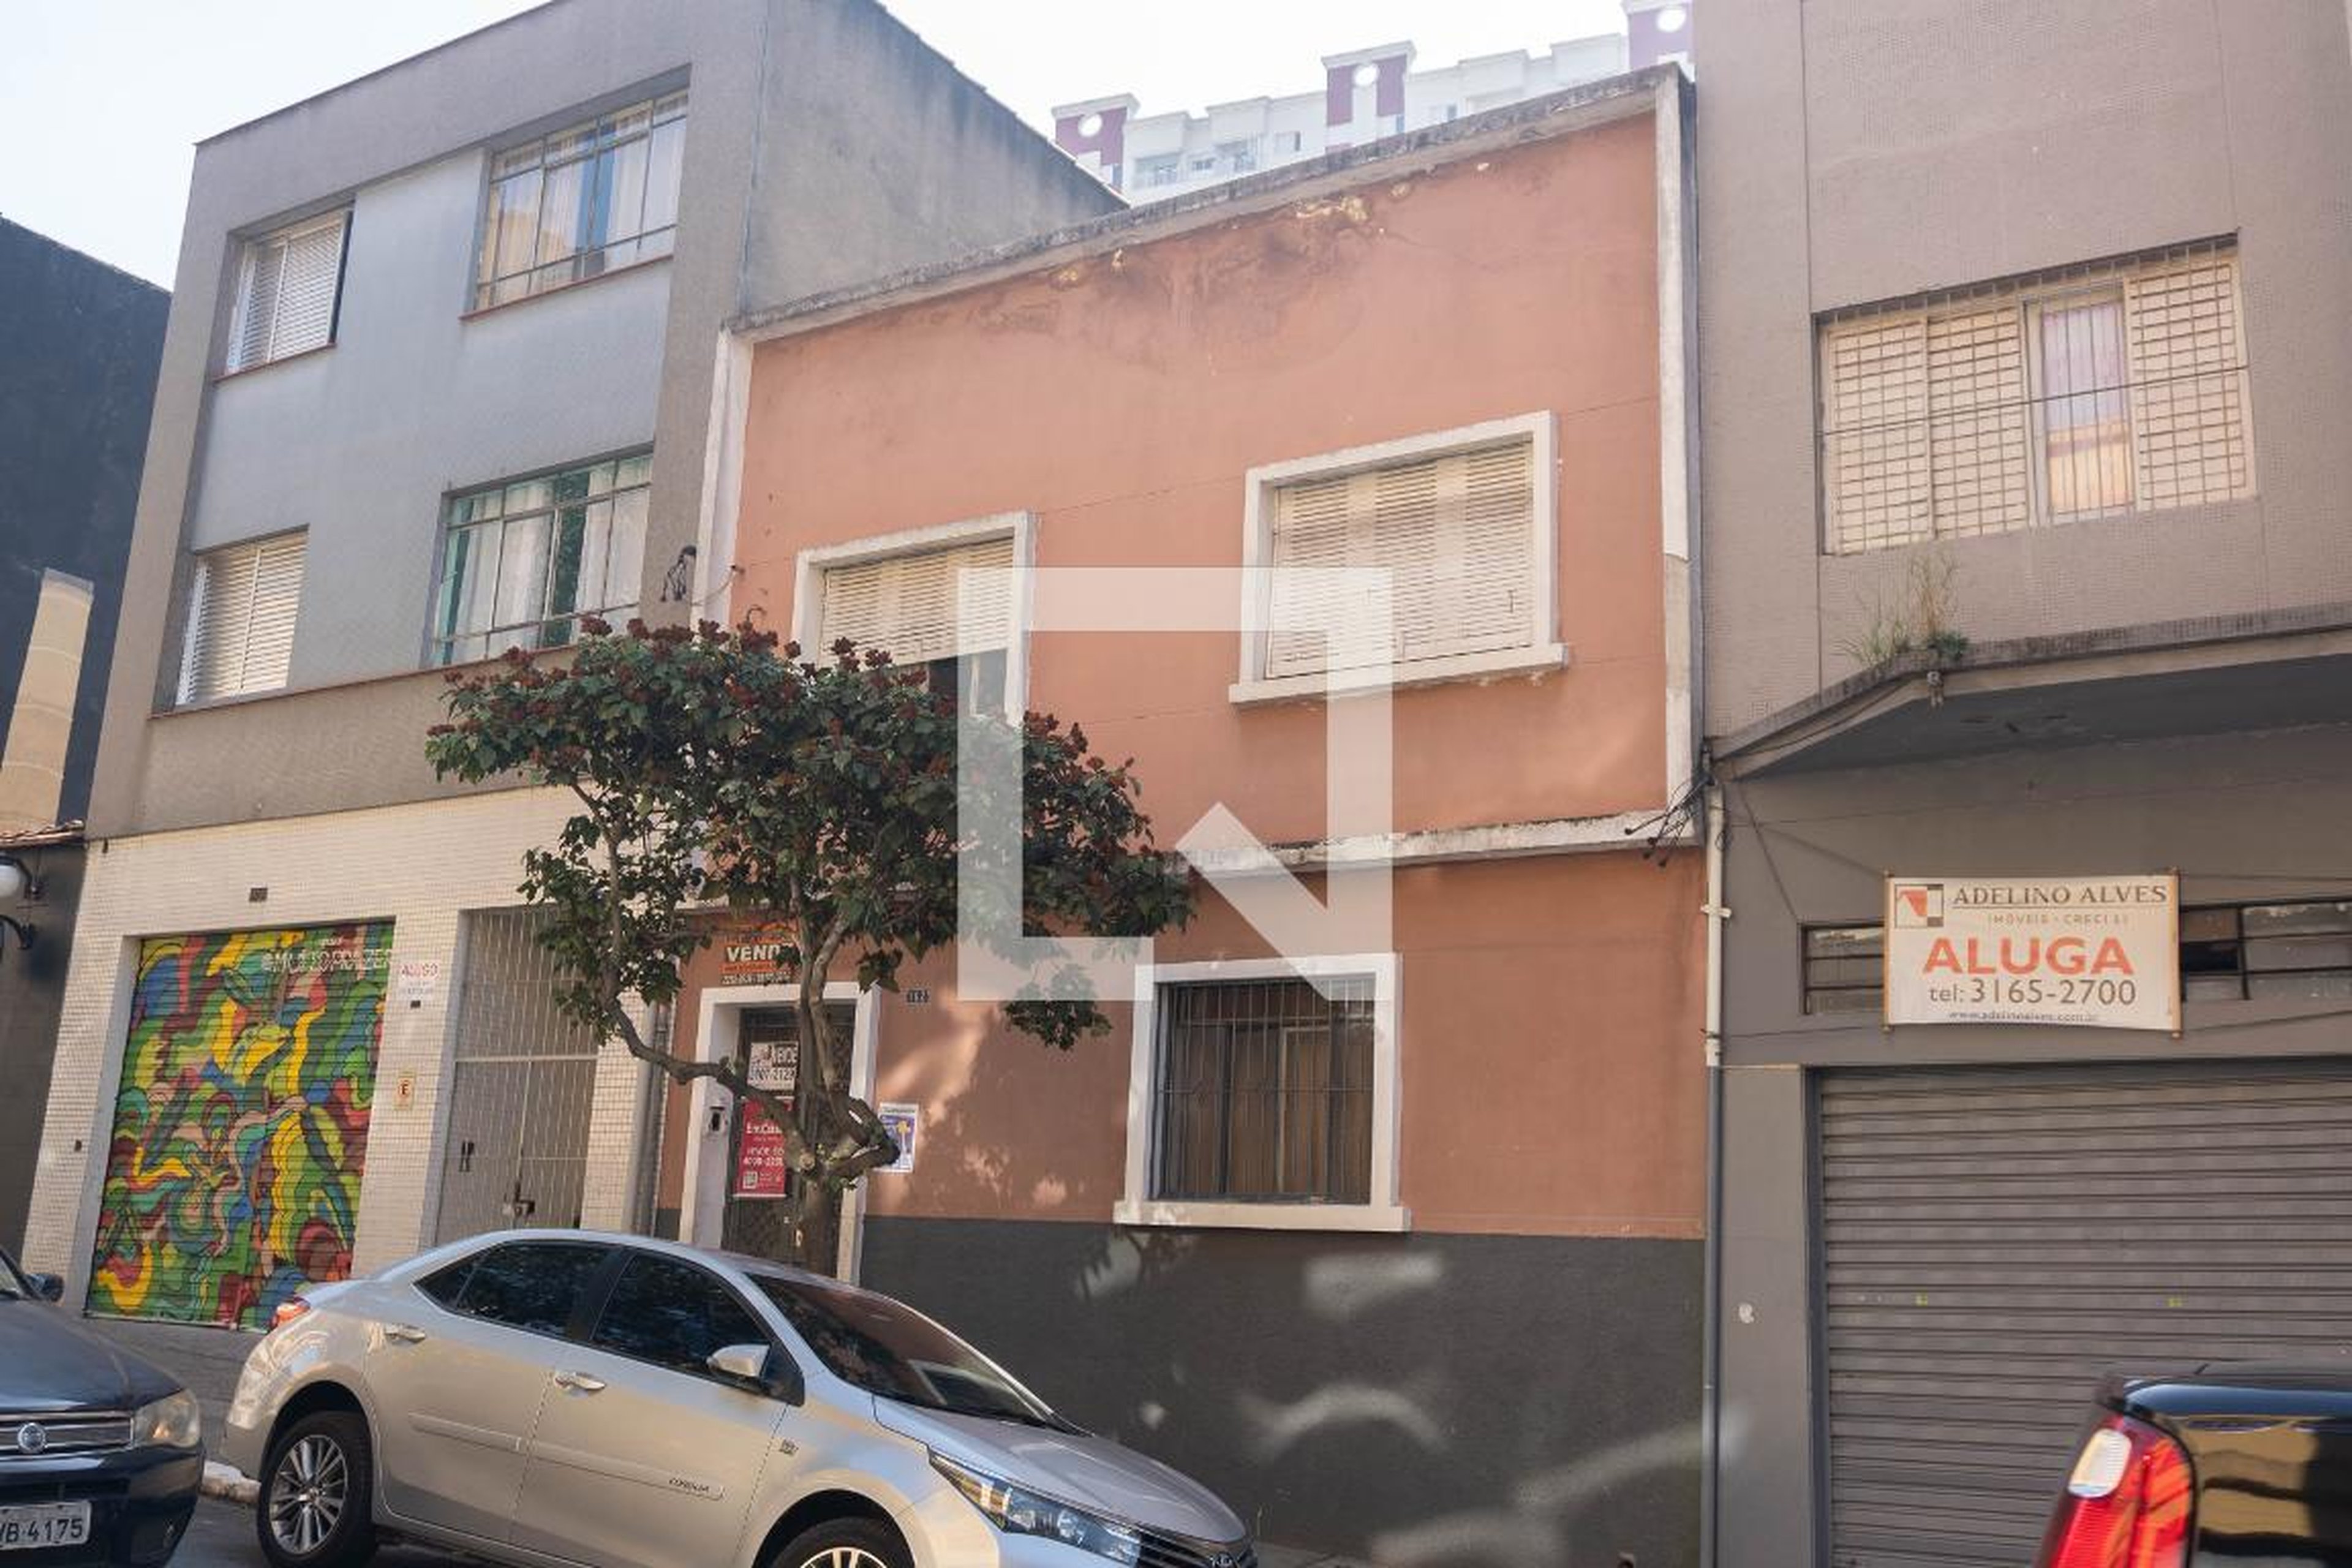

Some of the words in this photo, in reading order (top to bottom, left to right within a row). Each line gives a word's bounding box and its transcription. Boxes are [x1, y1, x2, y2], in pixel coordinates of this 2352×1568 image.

[1954, 887, 2071, 905] ADELINO
[2081, 885, 2167, 903] ALVES
[1922, 937, 2135, 976] ALUGA
[1930, 984, 1964, 1002] tel:
[1970, 979, 2136, 1005] 3165-2700
